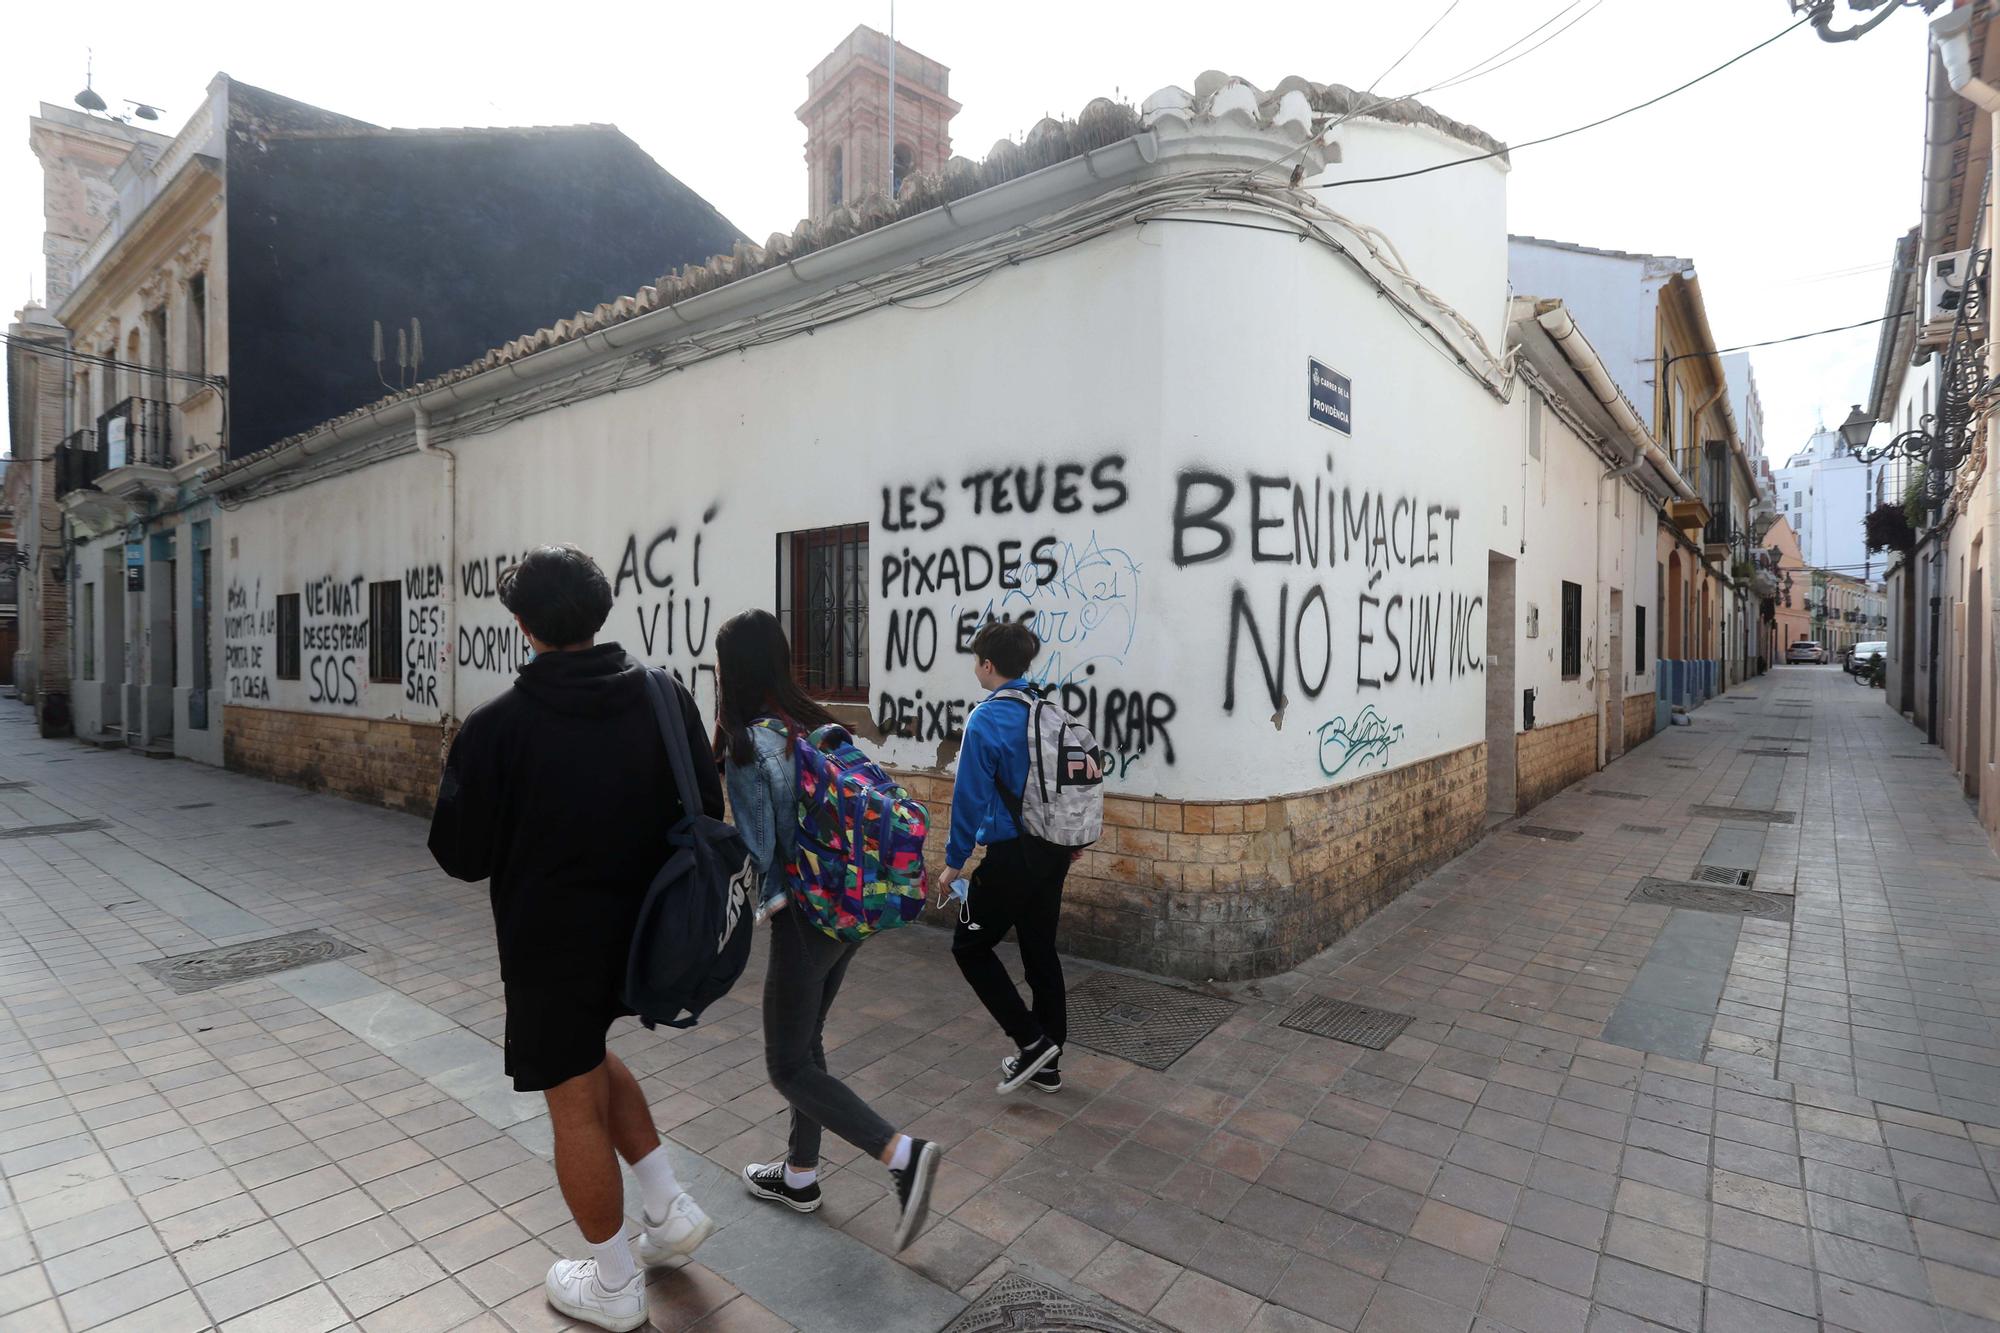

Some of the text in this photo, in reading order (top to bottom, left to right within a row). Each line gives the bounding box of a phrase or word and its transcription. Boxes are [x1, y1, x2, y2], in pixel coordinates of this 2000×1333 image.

[1320, 377, 1337, 393] CARRER
[881, 455, 1128, 532] LES TEUES
[614, 501, 721, 597] ACÍ
[305, 575, 364, 618] VEÏNAT
[259, 610, 266, 636] A
[303, 620, 369, 651] DESESPERAT
[408, 605, 439, 637] DES
[405, 638, 438, 672] CAN
[886, 606, 937, 673] NO
[1222, 581, 1331, 713] NO
[1356, 570, 1403, 695] ÉS
[1409, 591, 1441, 686] UN
[251, 645, 263, 669] DE
[242, 675, 271, 701] CASA
[406, 670, 439, 708] SAR
